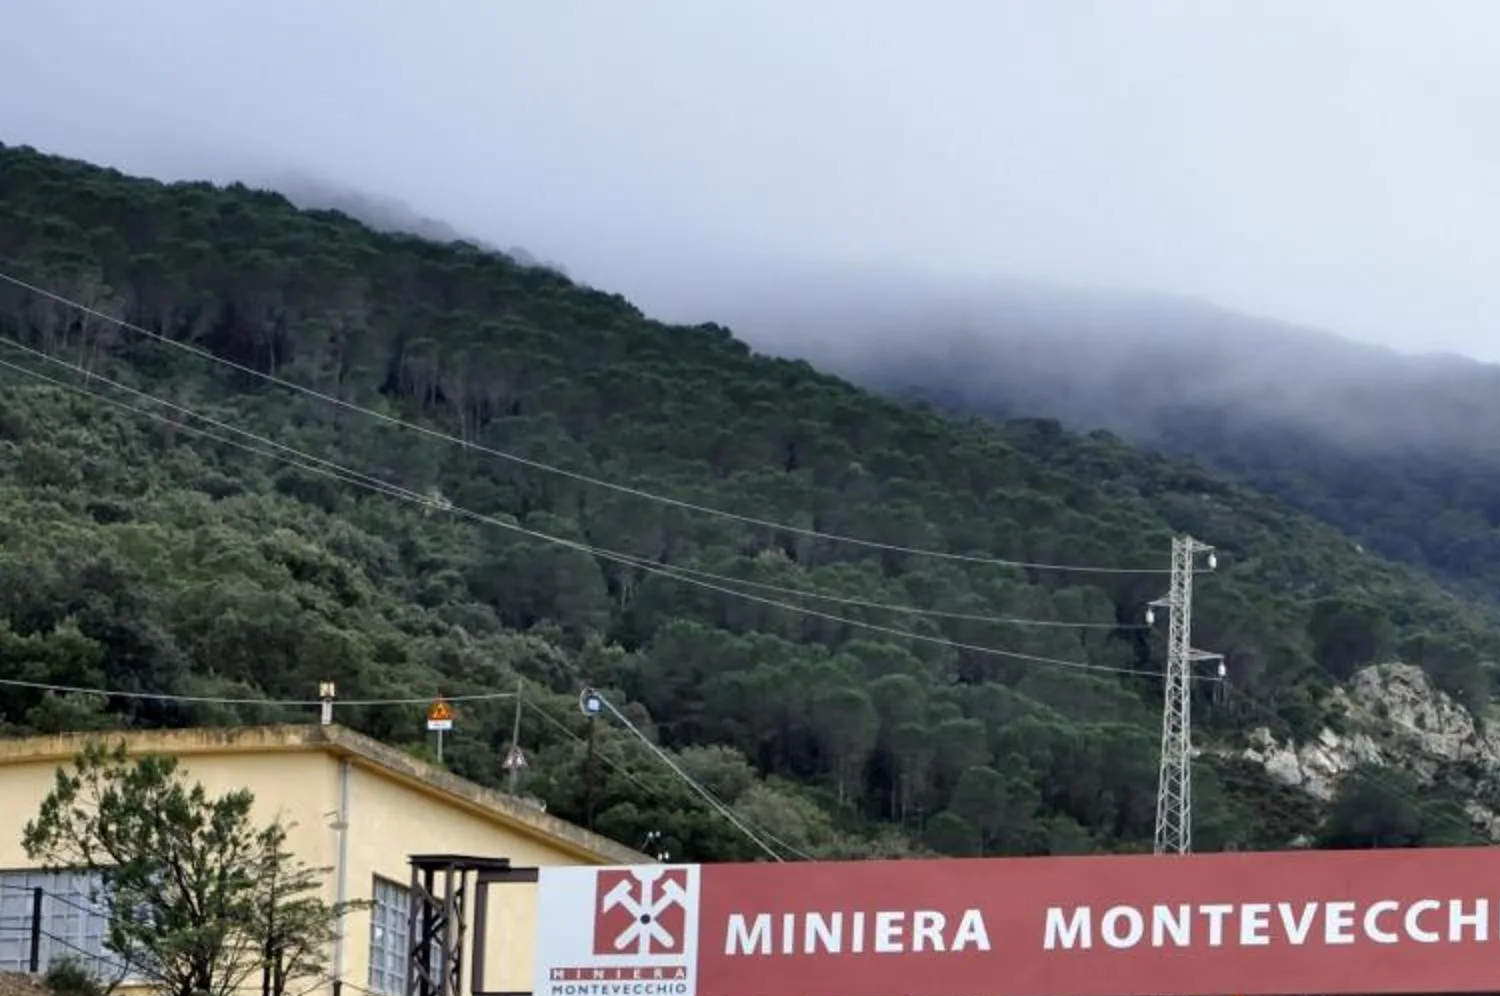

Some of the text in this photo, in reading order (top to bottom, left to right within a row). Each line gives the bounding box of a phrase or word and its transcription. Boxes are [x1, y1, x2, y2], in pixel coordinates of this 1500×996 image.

[724, 909, 991, 955] MINIERA
[553, 967, 685, 980] MINIERA
[552, 983, 687, 995] MONTEVECCHIO
